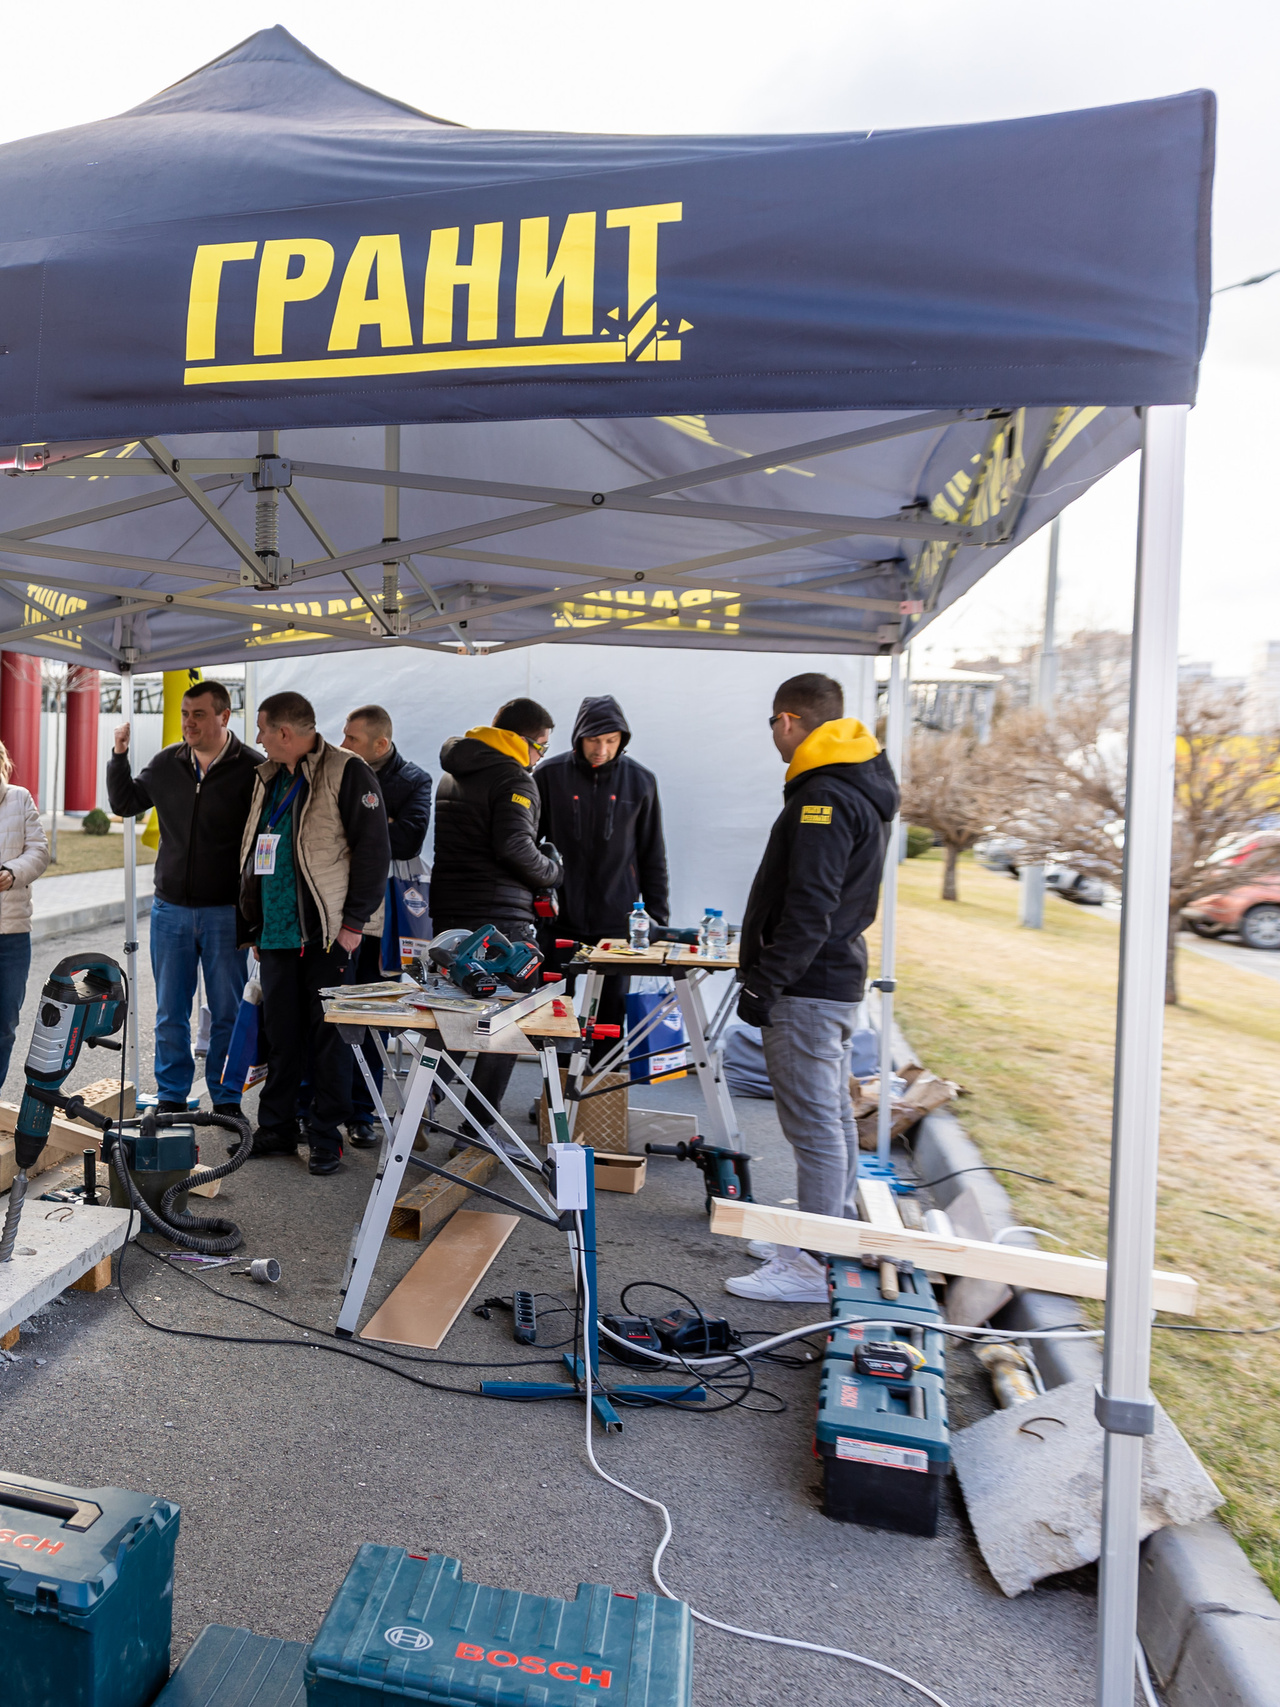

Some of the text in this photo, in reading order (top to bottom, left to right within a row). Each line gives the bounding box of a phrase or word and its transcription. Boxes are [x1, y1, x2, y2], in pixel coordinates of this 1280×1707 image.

[186, 201, 683, 361] ГРАНИТ
[68, 1027, 78, 1056] BOSCH
[455, 1642, 612, 1689] BOSCH
